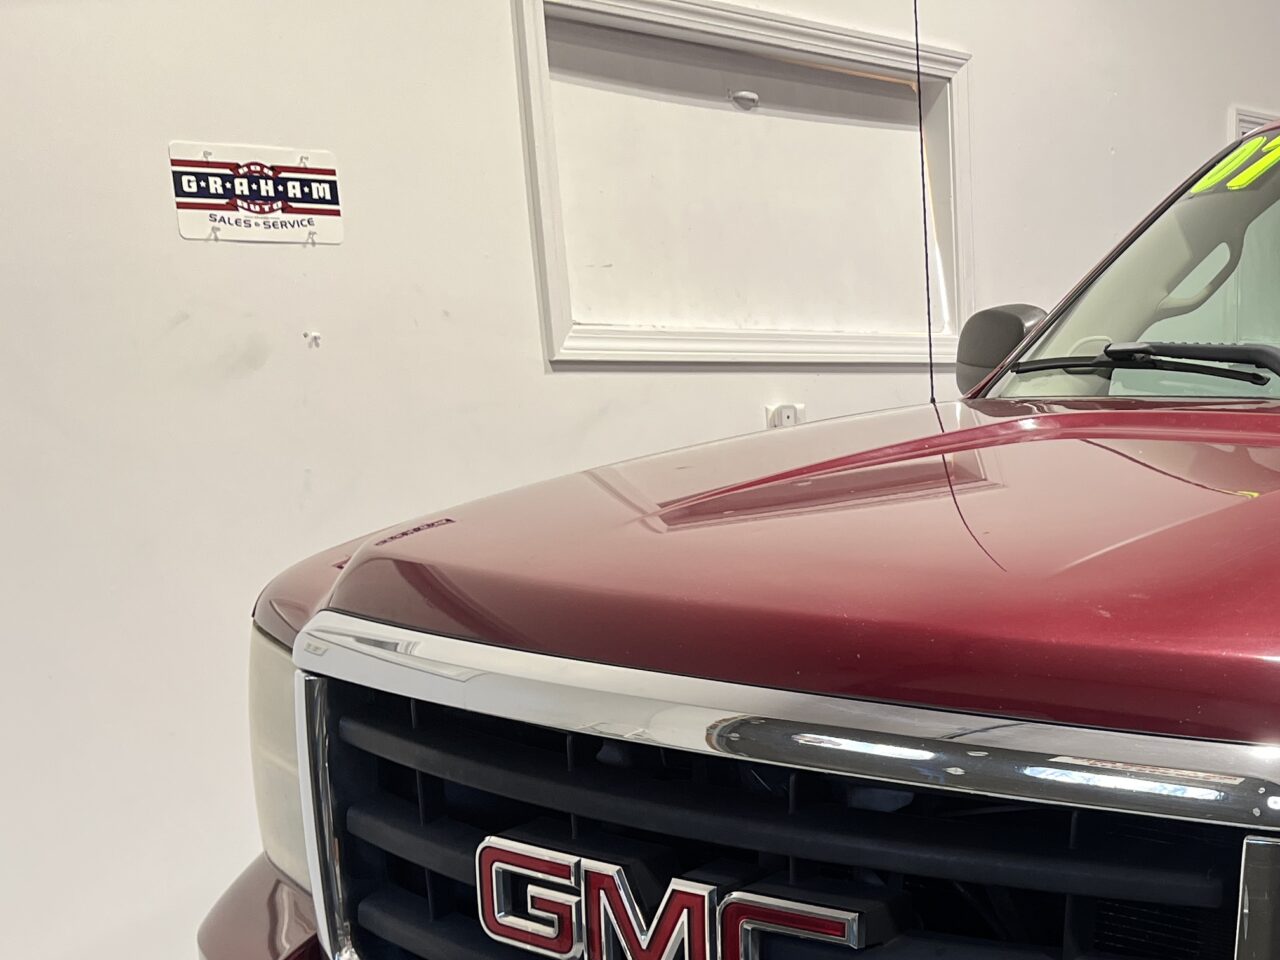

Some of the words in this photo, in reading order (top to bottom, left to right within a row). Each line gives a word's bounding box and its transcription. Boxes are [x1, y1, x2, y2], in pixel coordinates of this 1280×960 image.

[181, 174, 332, 200] GRAHAM
[236, 198, 283, 212] AUTO
[208, 213, 252, 228] SALES
[263, 217, 315, 230] SERVICE
